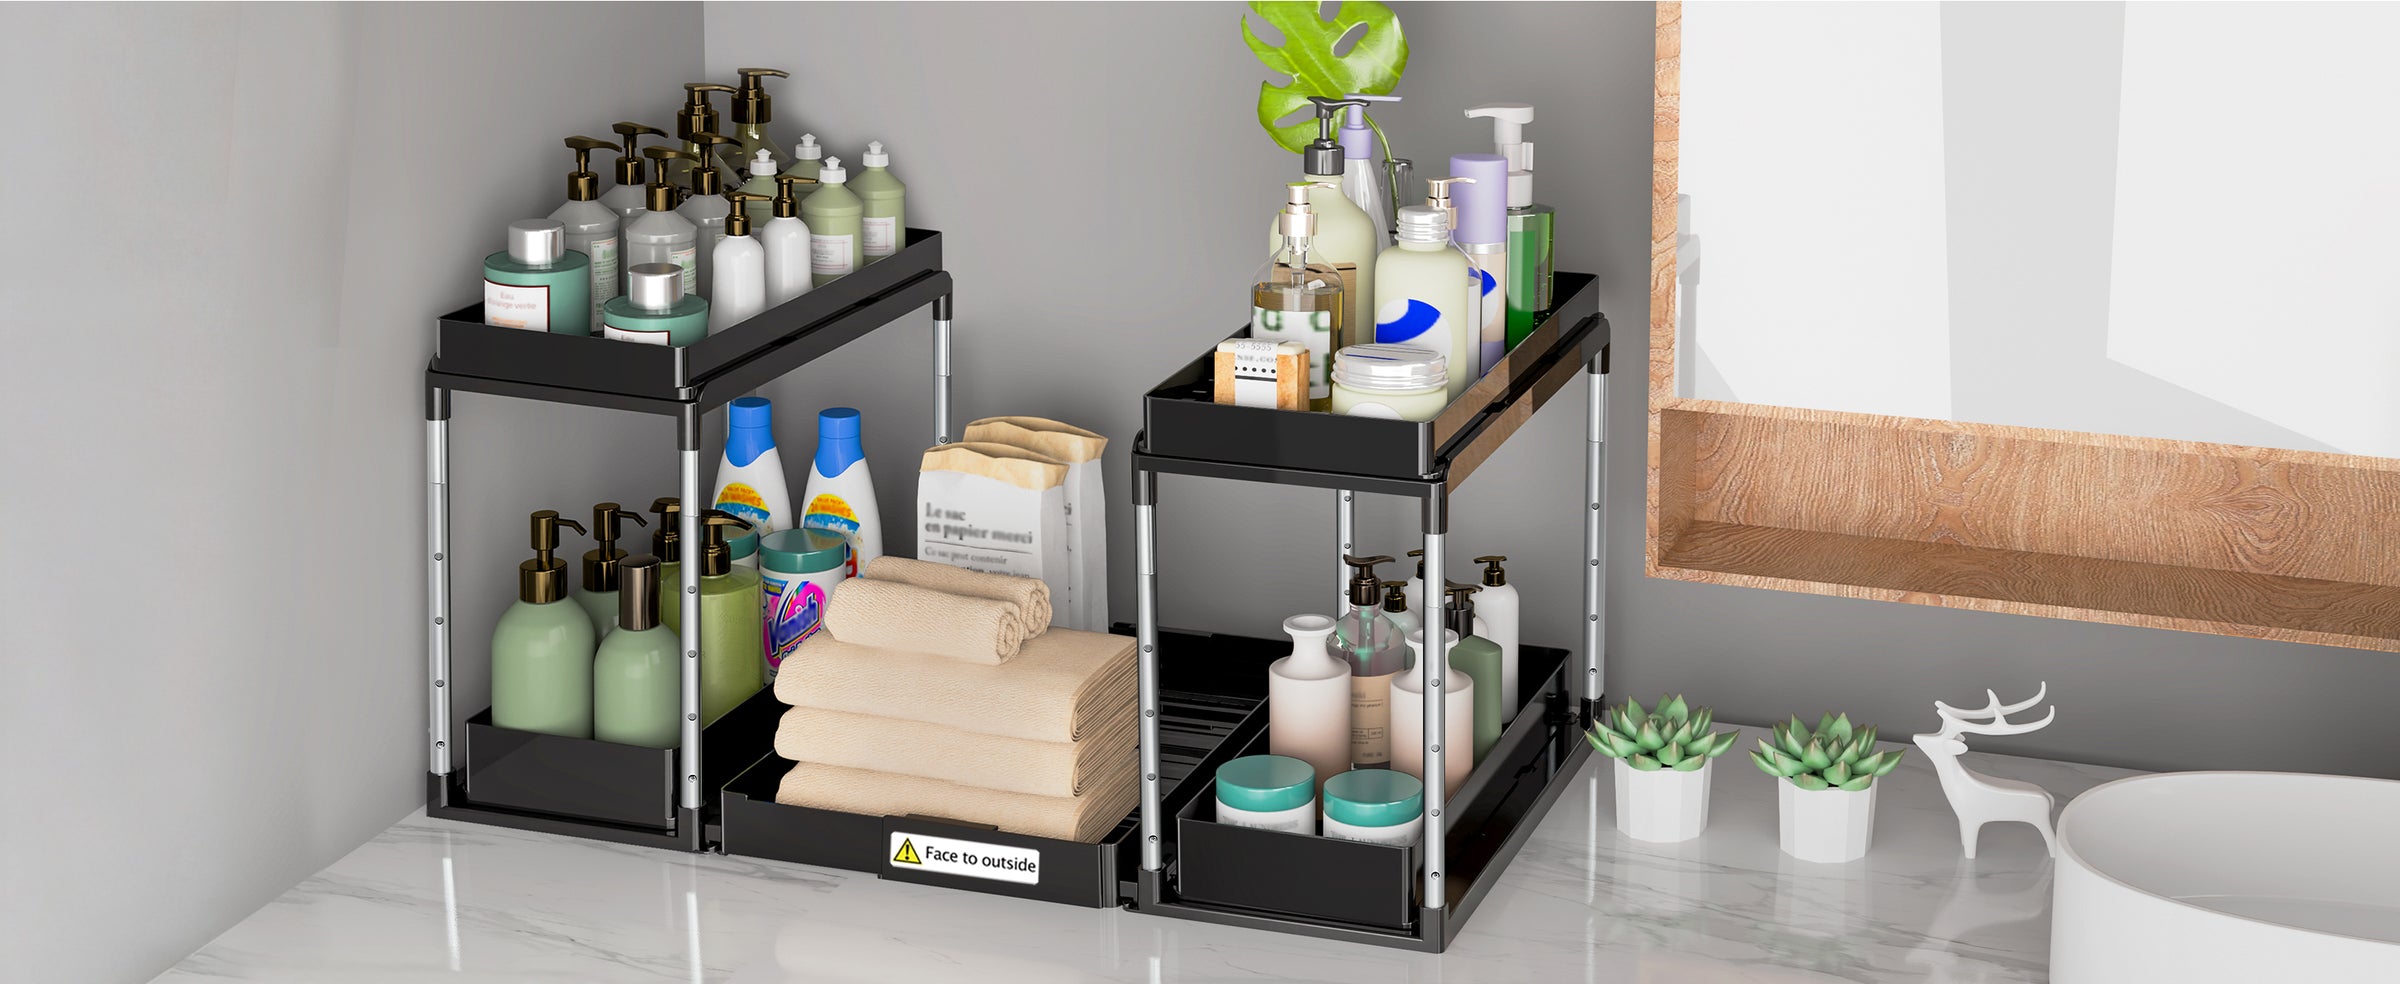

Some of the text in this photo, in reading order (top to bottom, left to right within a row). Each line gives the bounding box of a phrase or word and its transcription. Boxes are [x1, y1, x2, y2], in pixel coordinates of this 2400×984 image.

[925, 502, 966, 521] Le sac
[925, 521, 1033, 544] en papier merci
[926, 846, 1036, 873] Face to outside
